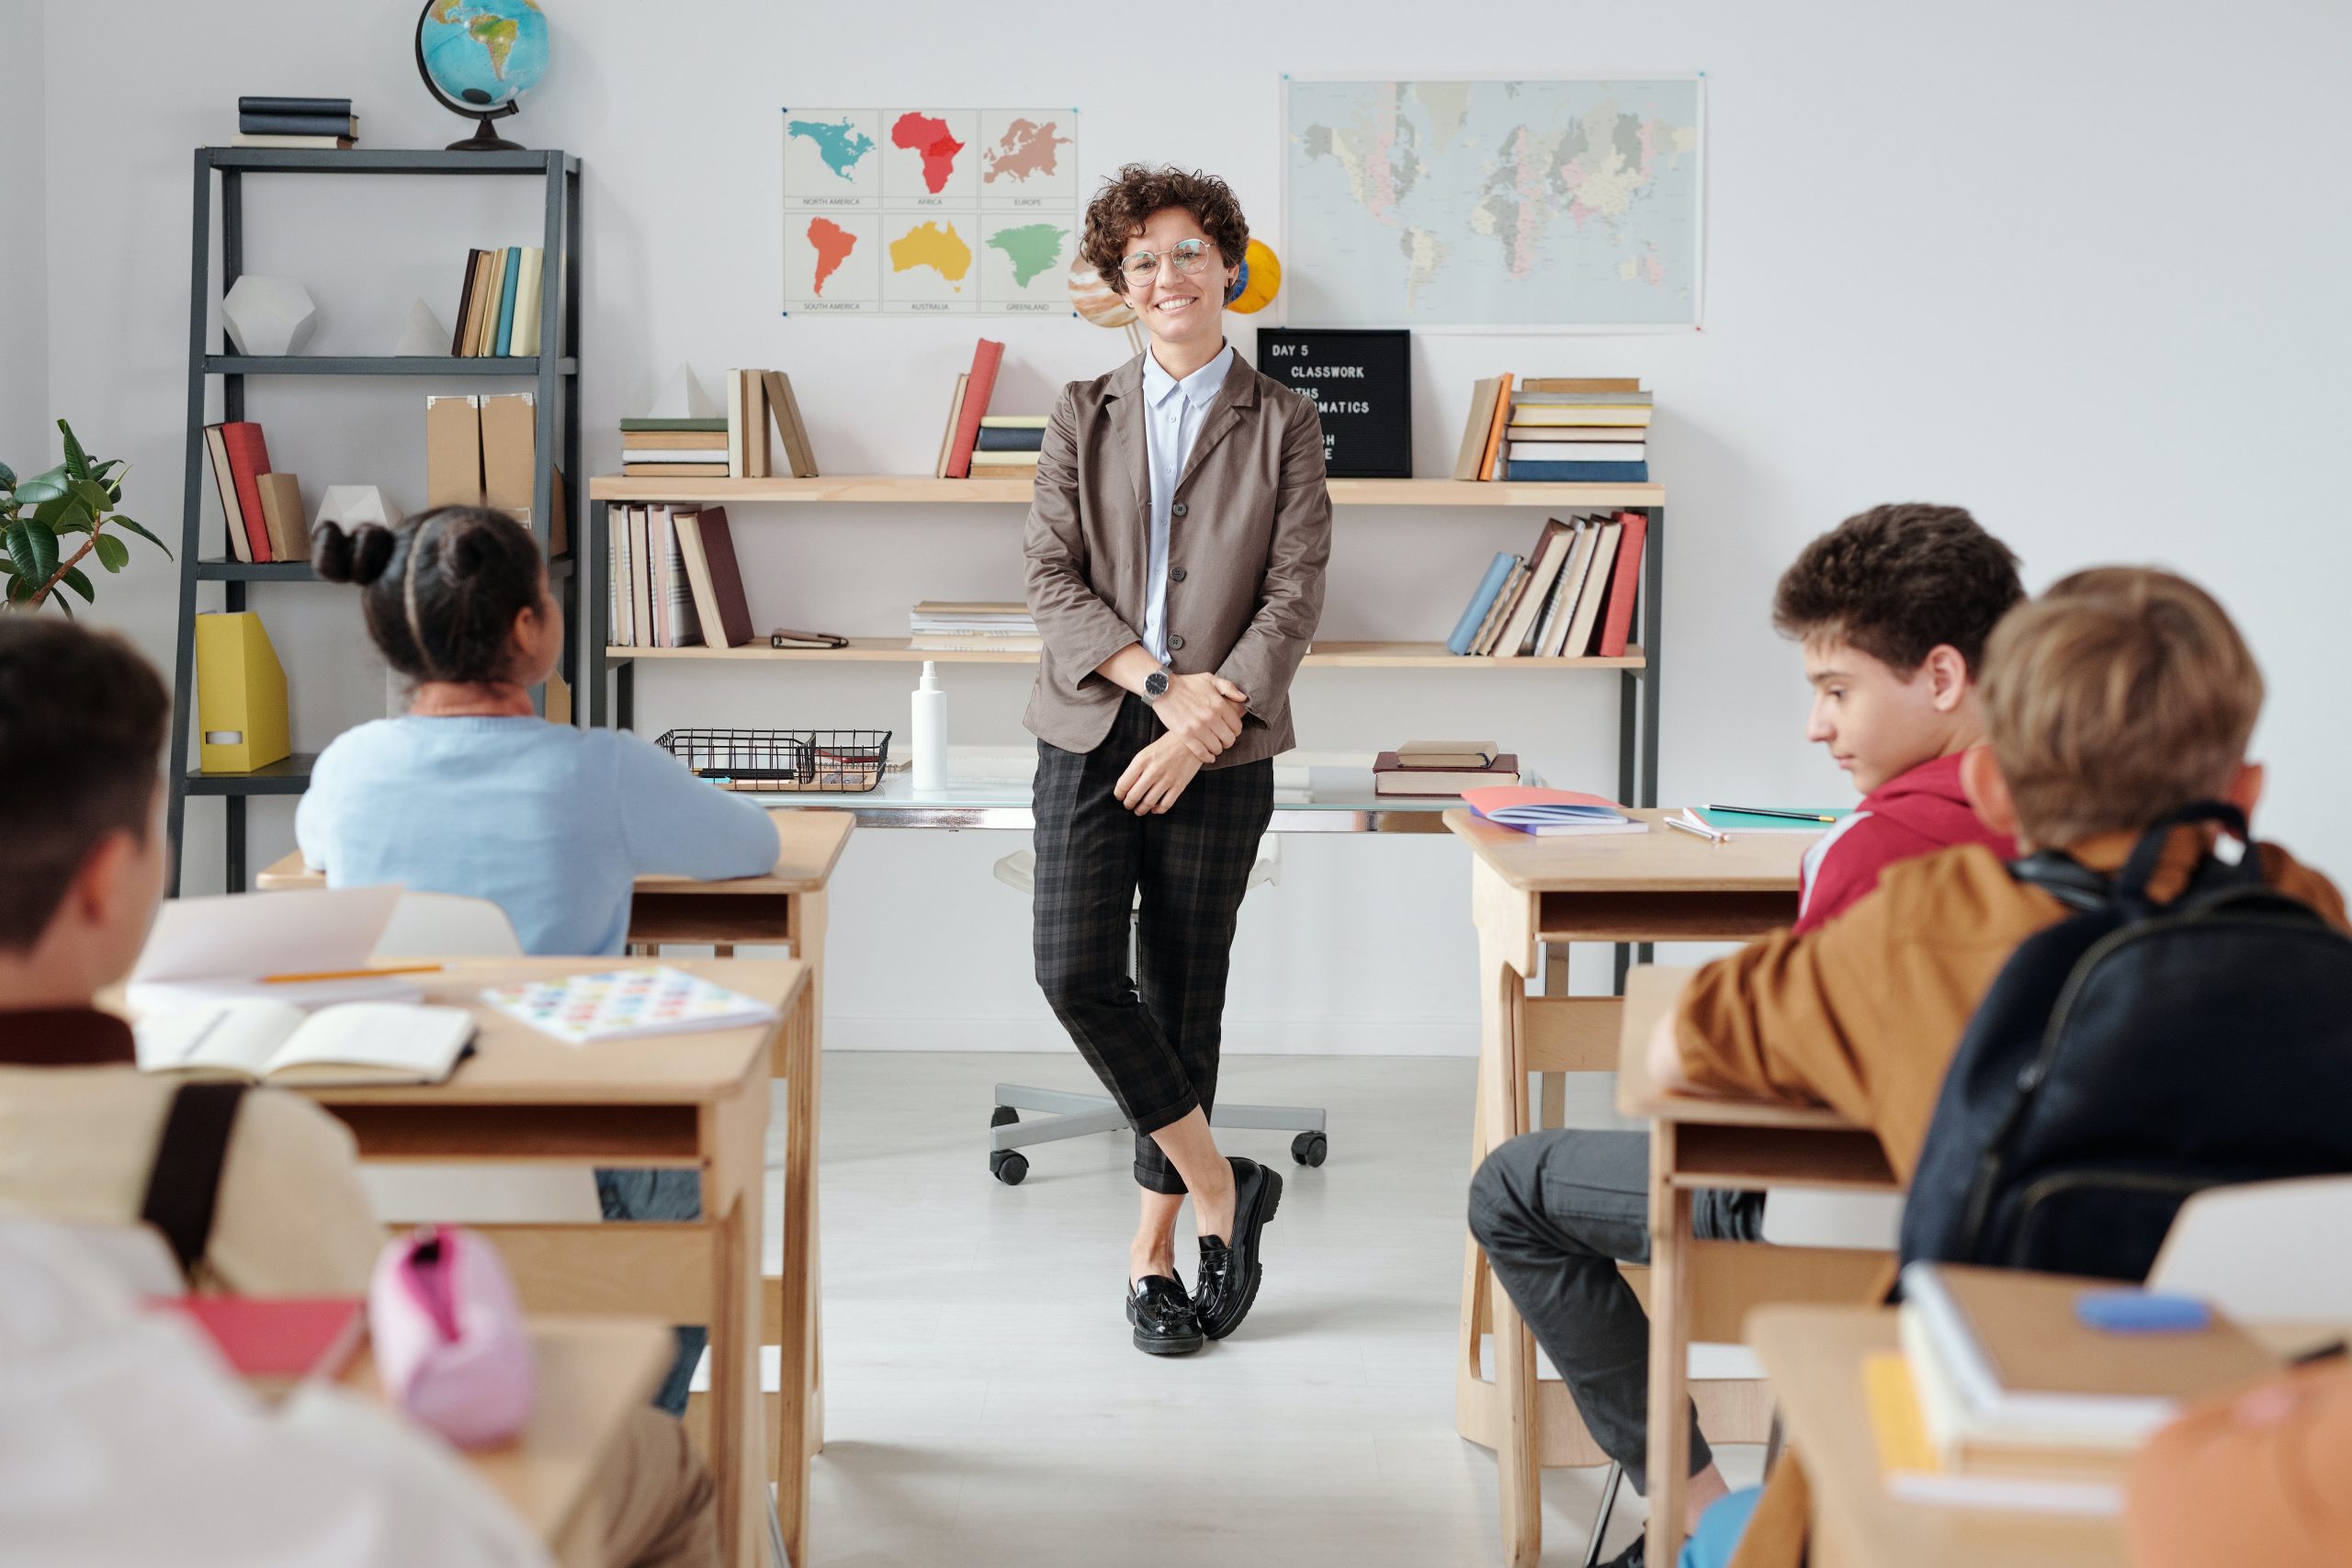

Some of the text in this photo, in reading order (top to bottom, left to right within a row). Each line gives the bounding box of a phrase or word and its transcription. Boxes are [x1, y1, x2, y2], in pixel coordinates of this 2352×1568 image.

[1014, 198, 1041, 207] EUROPE
[1006, 303, 1049, 311] GREENLAND
[1272, 344, 1308, 356] DAY 5
[1291, 367, 1364, 378] CLASSWORK
[1291, 388, 1319, 400] THS
[1314, 401, 1370, 413] MATICS
